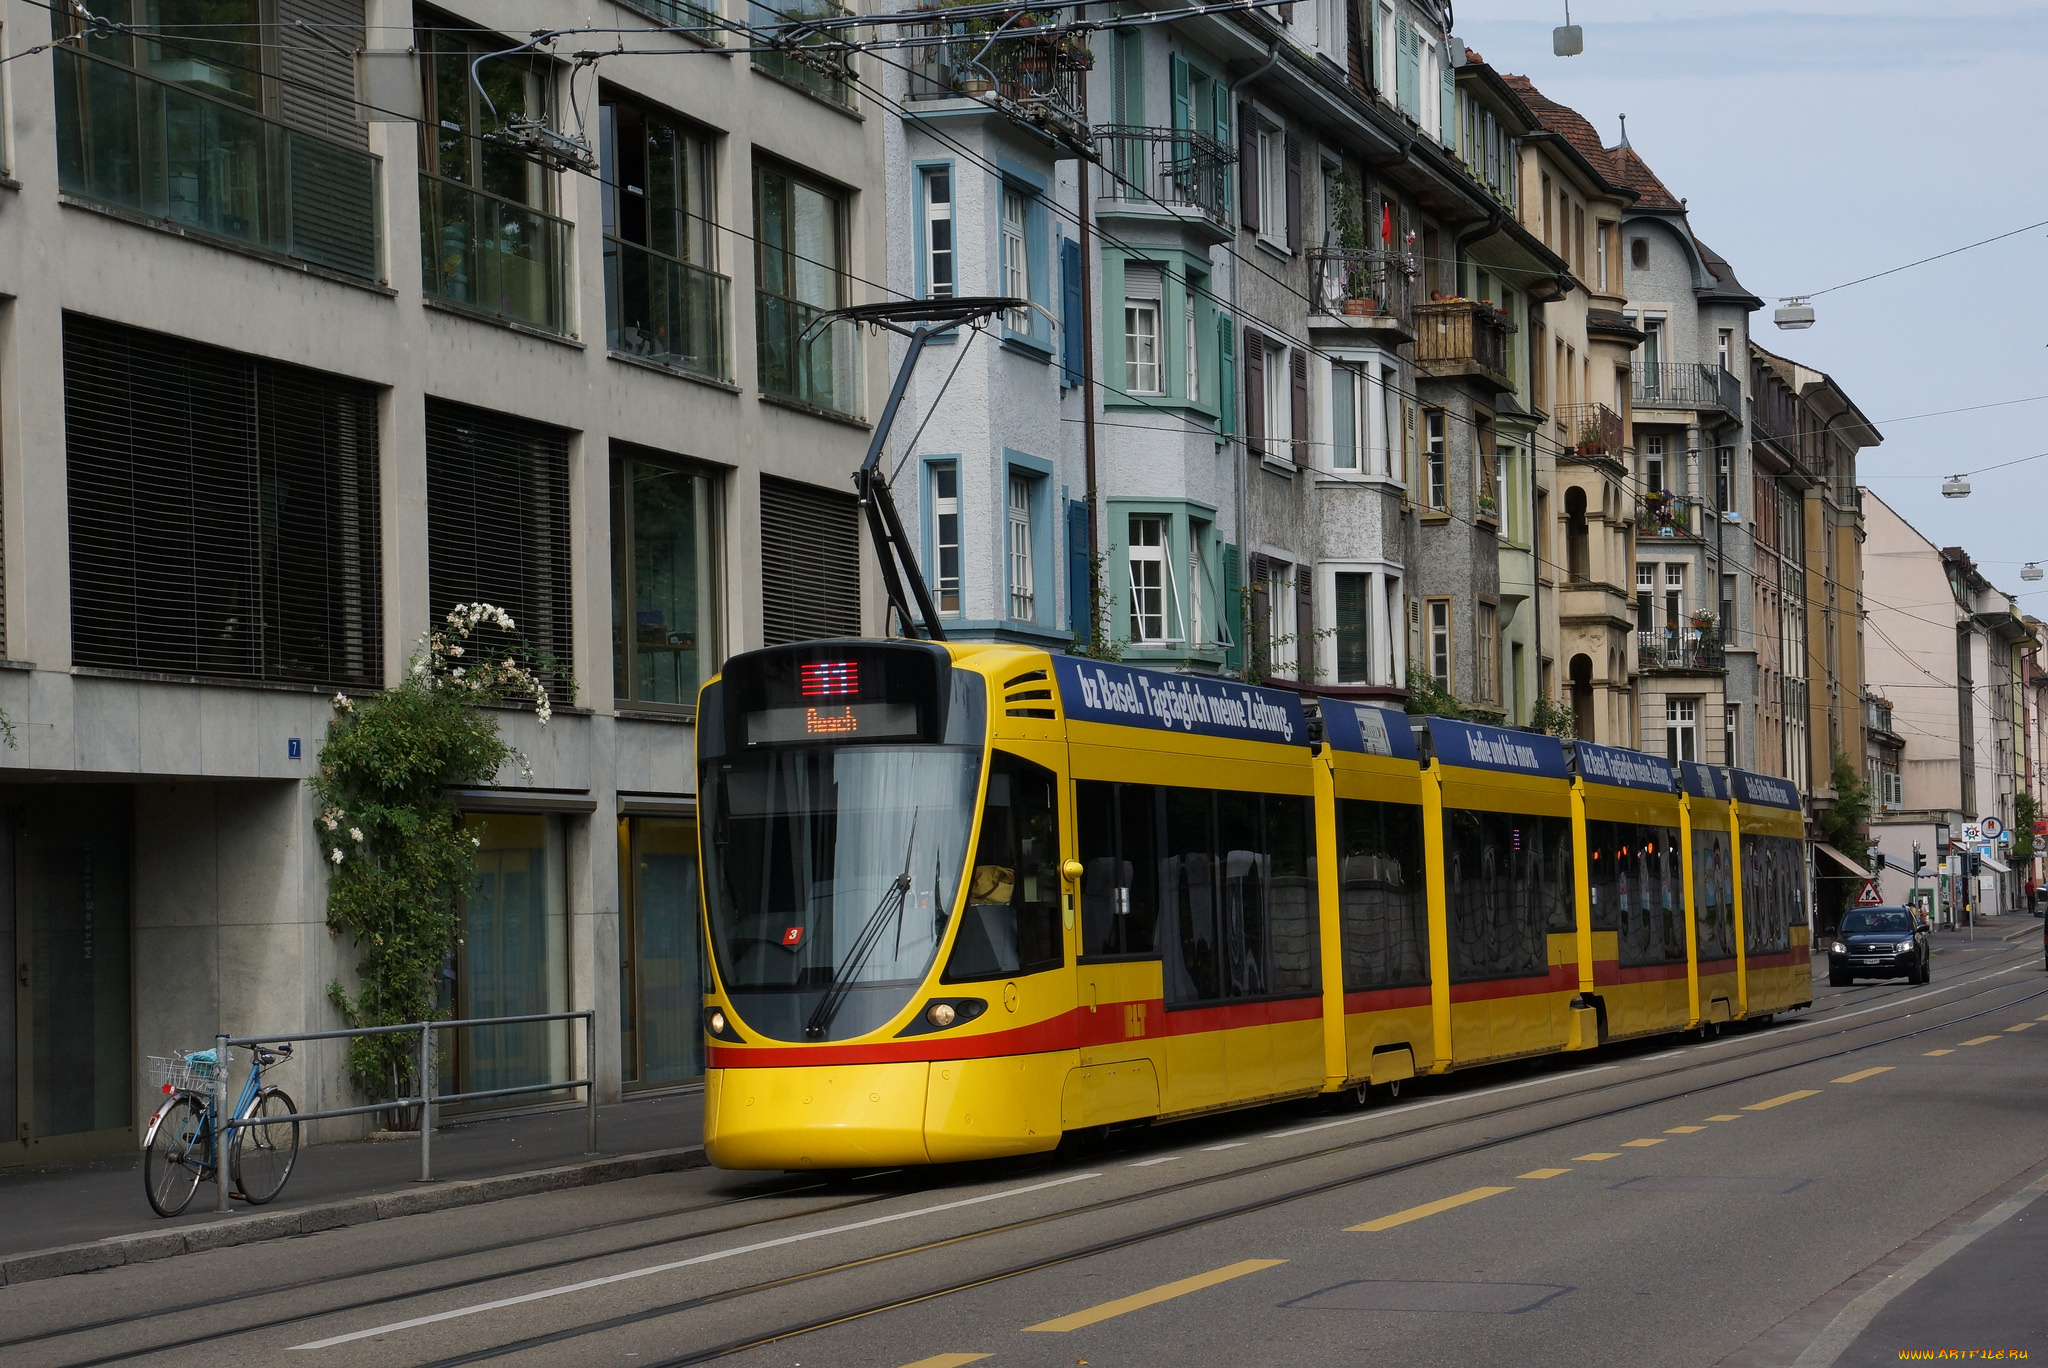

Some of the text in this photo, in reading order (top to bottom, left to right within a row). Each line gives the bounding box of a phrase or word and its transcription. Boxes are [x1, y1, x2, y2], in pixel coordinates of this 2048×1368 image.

[814, 663, 848, 695] 11
[1076, 664, 1294, 742] bz Basel. Tagtäglich meine Zeitung.
[807, 706, 858, 733] Aesch
[292, 741, 298, 756] 7
[1489, 734, 1508, 765] und
[1501, 734, 1519, 766] bis
[788, 928, 799, 940] 3
[1124, 1003, 1147, 1038] BLT
